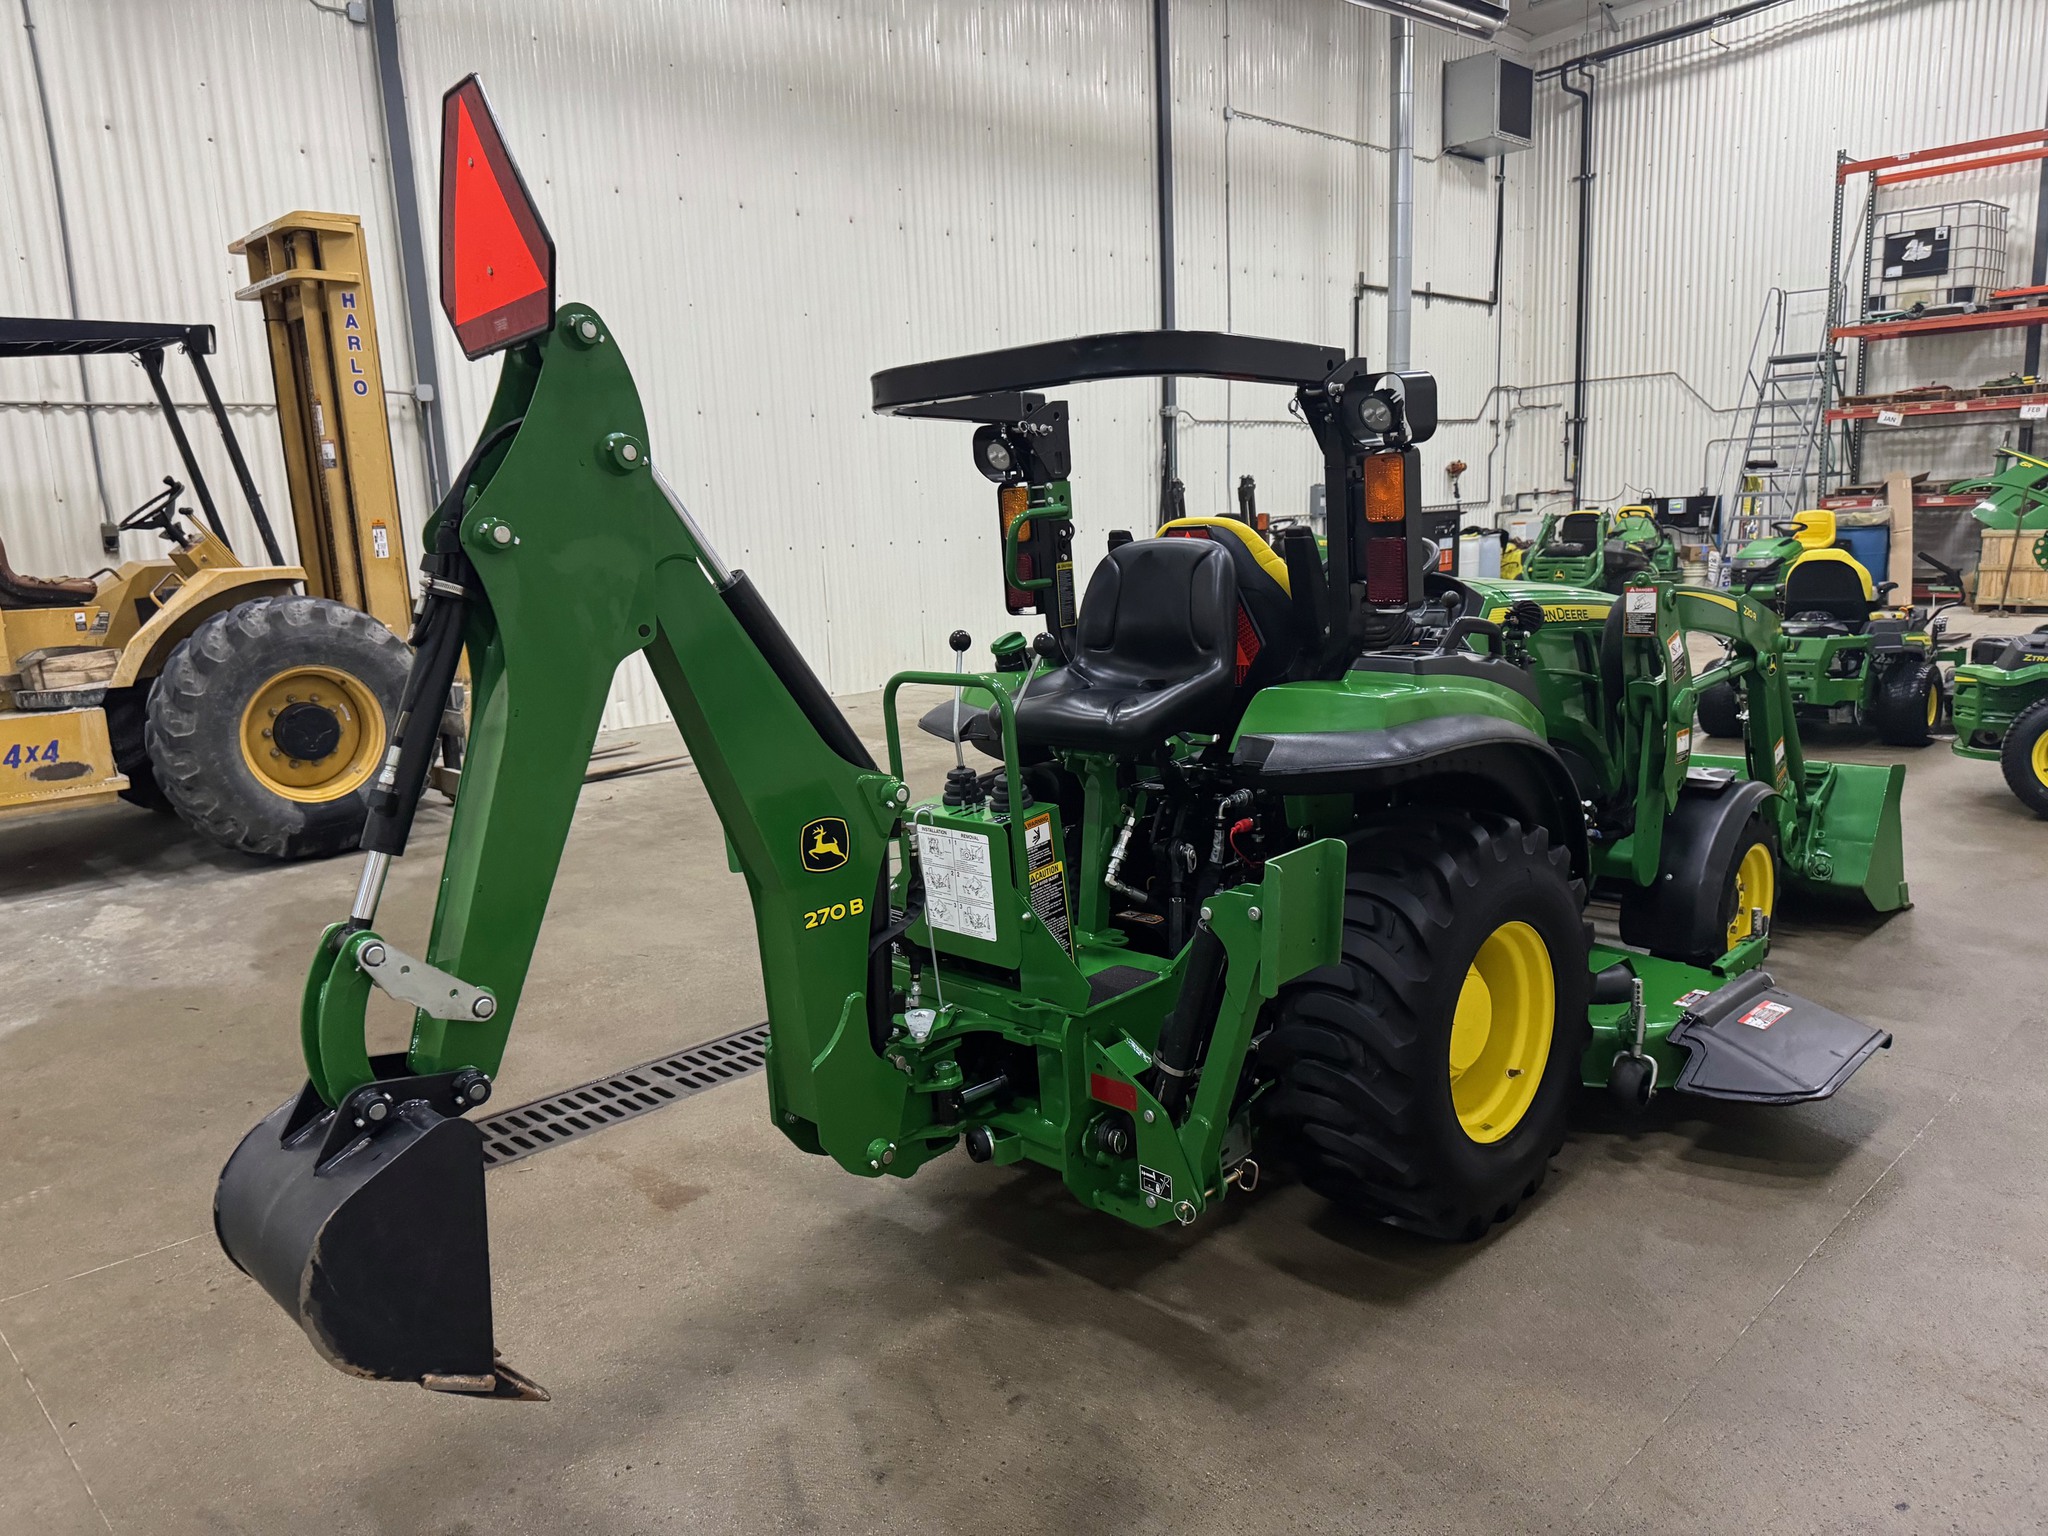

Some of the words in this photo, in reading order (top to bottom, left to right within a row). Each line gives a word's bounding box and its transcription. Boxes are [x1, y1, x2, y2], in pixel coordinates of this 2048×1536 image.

[341, 292, 368, 396] HARLO
[1556, 607, 1589, 620] DEERE
[2, 739, 60, 769] 4x4
[1027, 815, 1049, 828] WARNING
[921, 826, 948, 836] INSTALLATION
[960, 832, 980, 841] REMOVAL
[1035, 864, 1059, 881] CAUTION
[803, 903, 847, 930] 270
[849, 897, 865, 916] B
